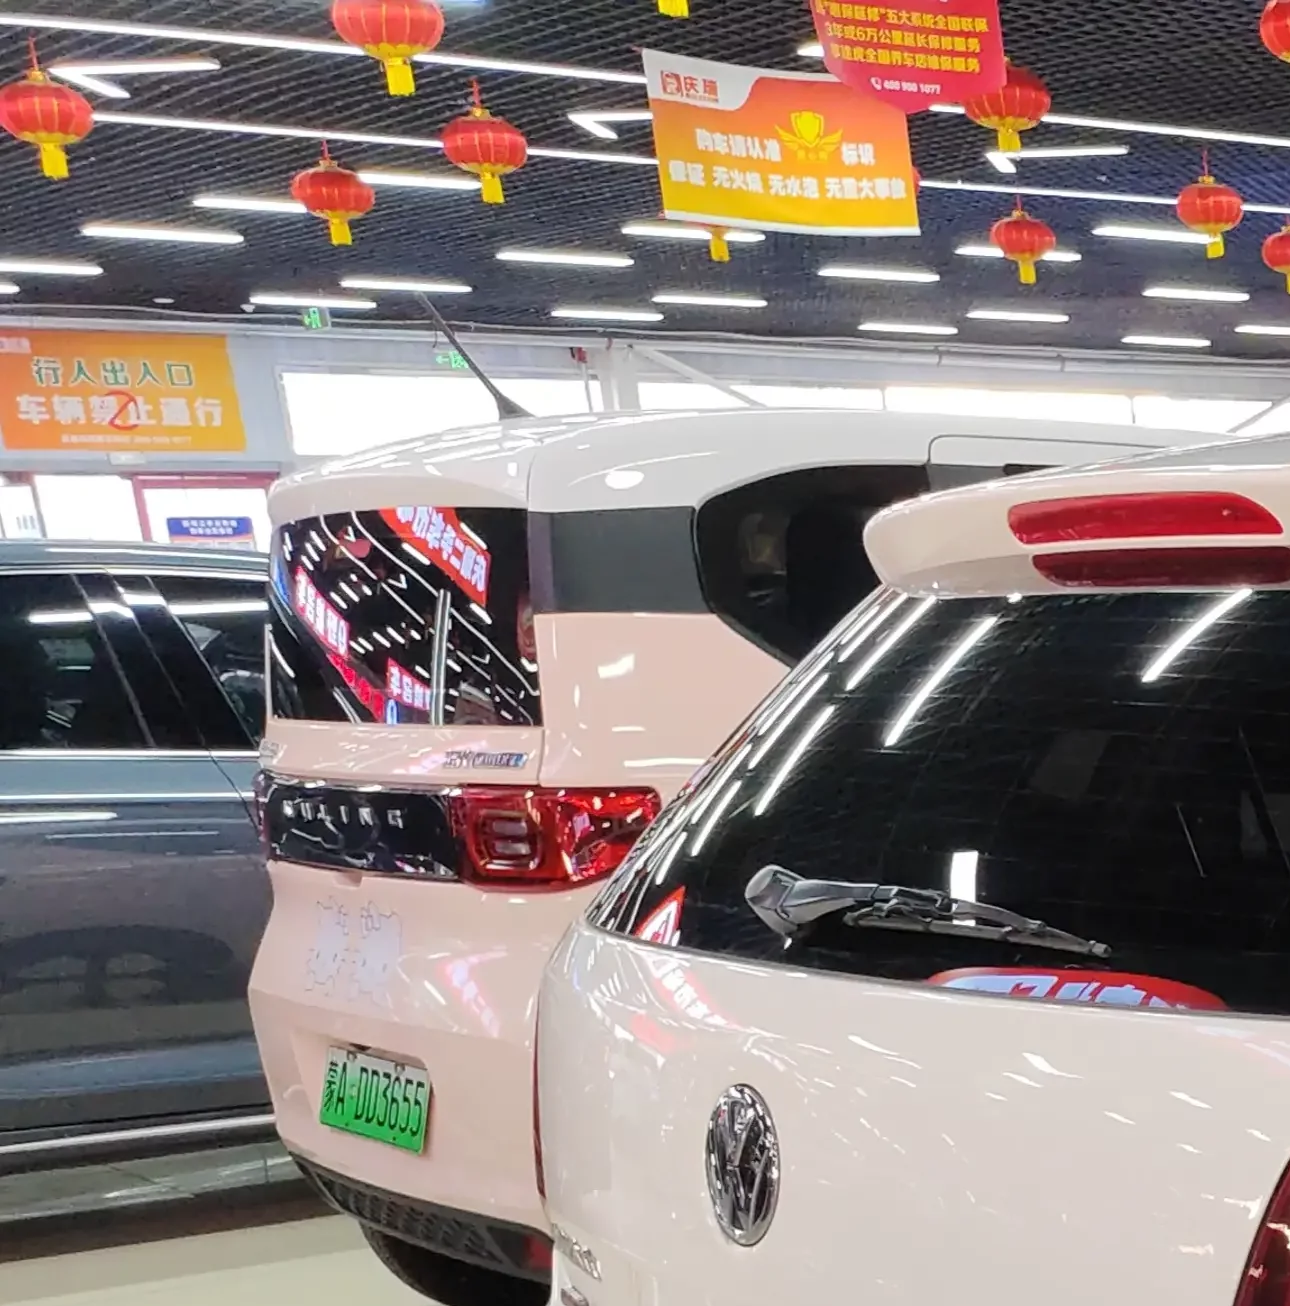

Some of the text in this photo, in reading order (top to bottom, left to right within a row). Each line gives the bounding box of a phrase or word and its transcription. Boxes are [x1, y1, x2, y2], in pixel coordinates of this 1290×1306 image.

[32, 355, 195, 387] 行人出入口
[16, 393, 224, 428] 车辆禁止通行
